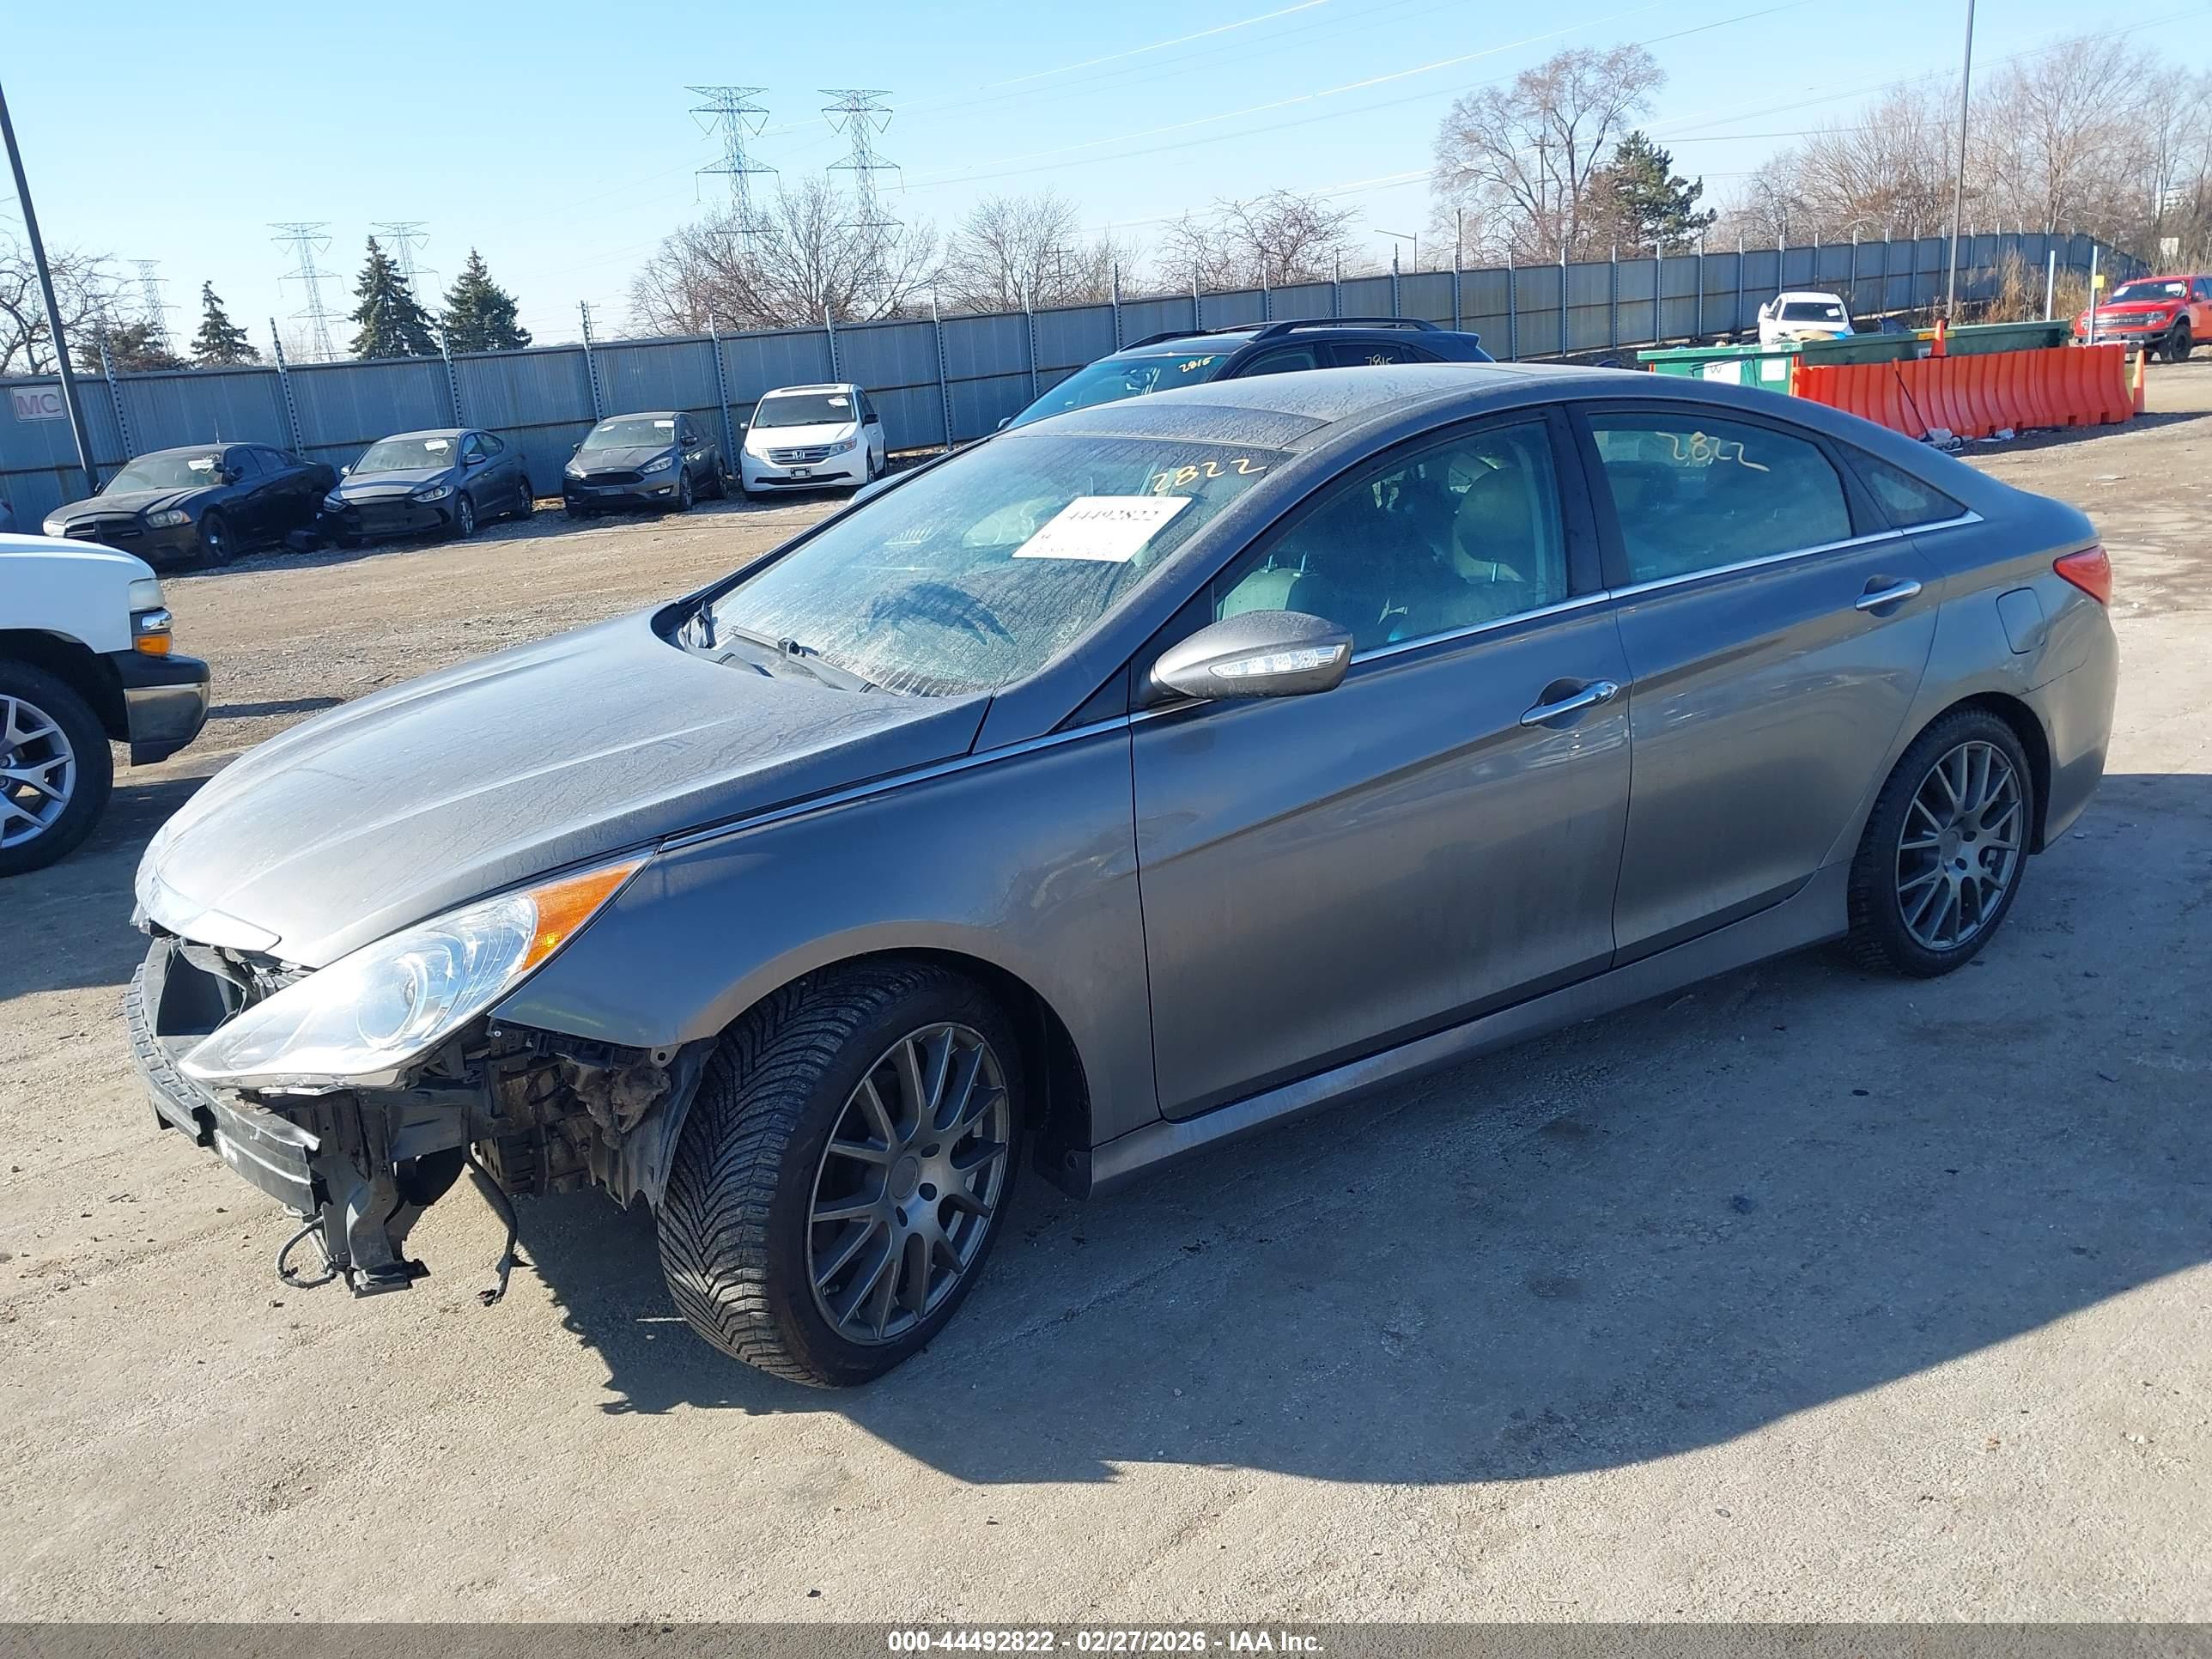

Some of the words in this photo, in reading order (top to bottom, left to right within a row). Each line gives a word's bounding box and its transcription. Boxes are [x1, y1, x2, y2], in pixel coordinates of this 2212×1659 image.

[15, 394, 61, 415] MC
[1656, 430, 1771, 472] 2822
[1152, 458, 1268, 492] 2822
